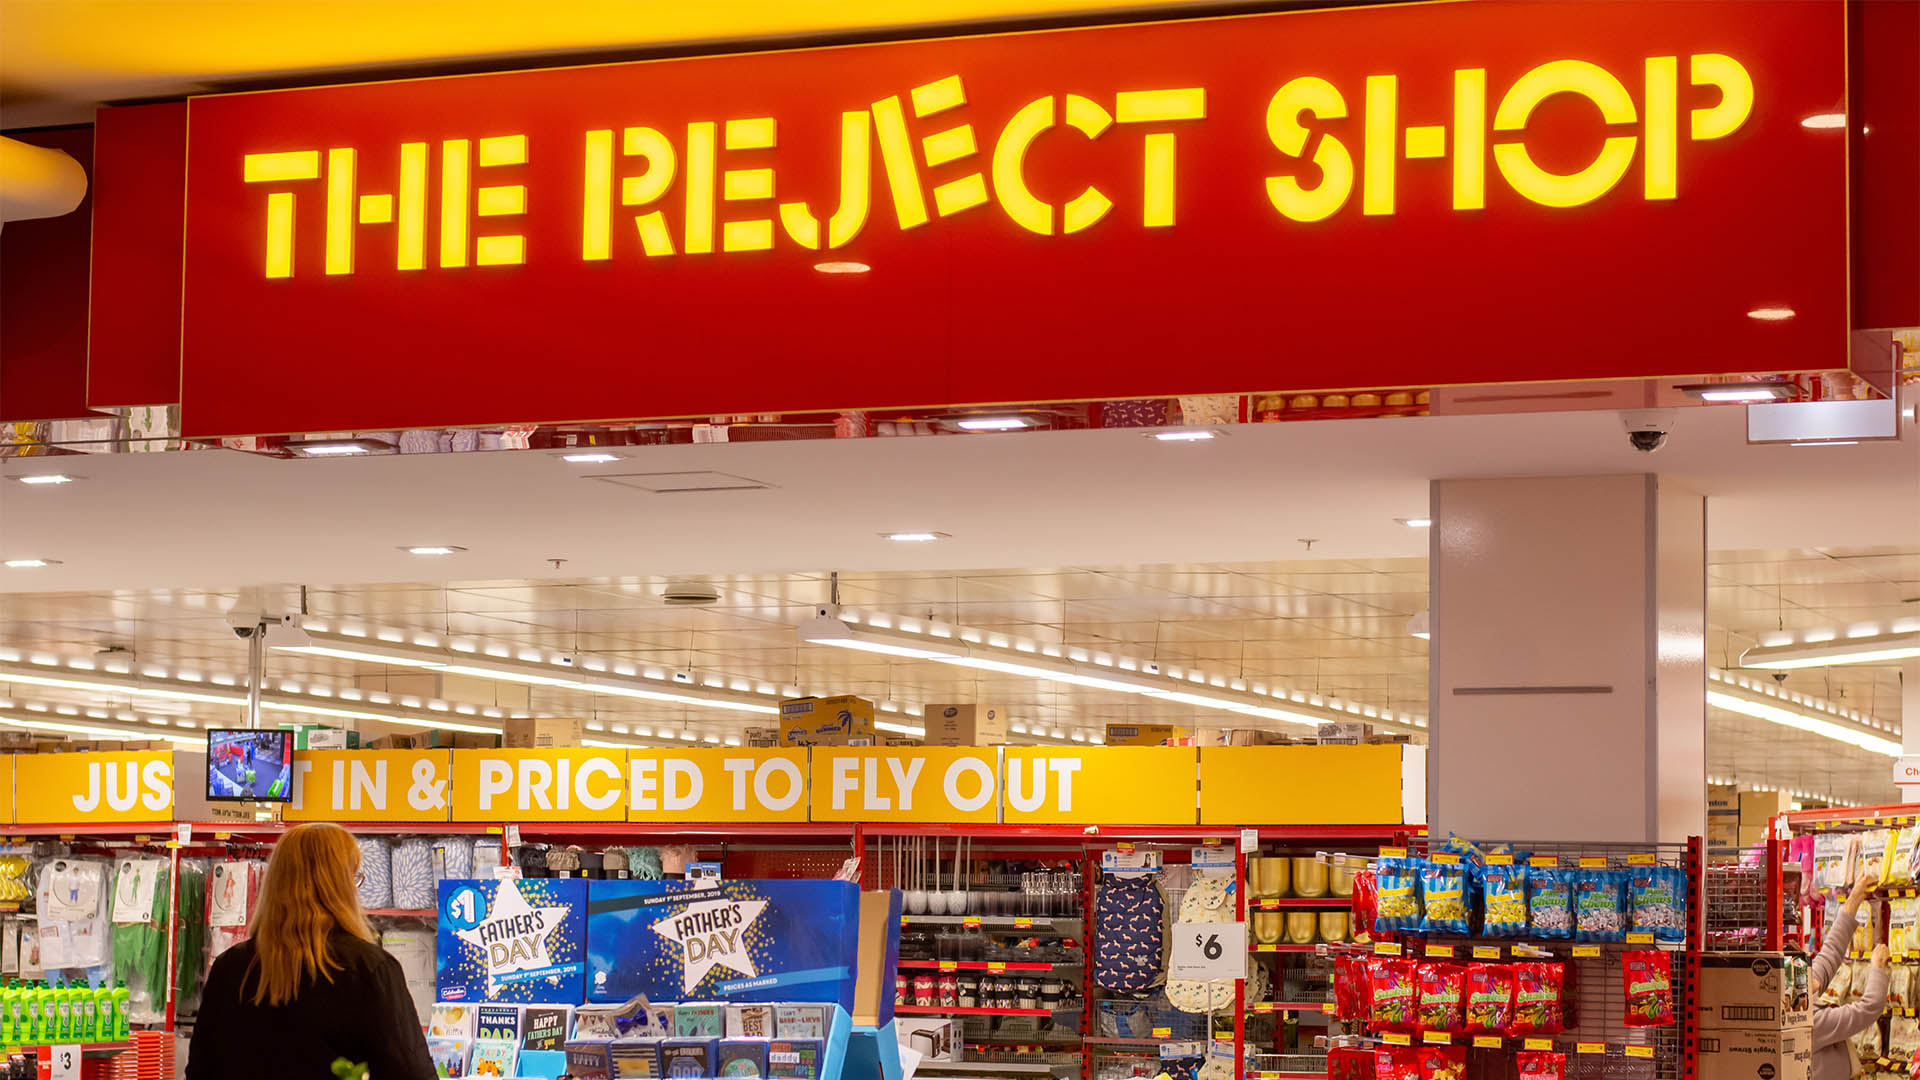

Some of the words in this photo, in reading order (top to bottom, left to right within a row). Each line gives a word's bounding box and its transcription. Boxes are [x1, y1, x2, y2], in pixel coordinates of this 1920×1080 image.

[244, 134, 528, 278] THE
[582, 74, 1206, 261] REJECT
[1265, 53, 1754, 222] SHOP
[331, 759, 387, 810] IN
[407, 758, 447, 811] &
[479, 757, 703, 811] PRICED
[724, 757, 803, 811] TO
[832, 757, 926, 811] FLY
[943, 756, 1082, 812] OUT
[451, 889, 475, 923] $1
[644, 896, 665, 905] SUNDAY
[707, 890, 721, 898] 2019
[479, 910, 545, 946] FATHER'S
[675, 904, 742, 940] FATHER'S
[489, 933, 542, 969] DAY
[686, 928, 740, 965] DAY
[1195, 933, 1223, 960] $6
[480, 1016, 516, 1025] THANKS
[480, 1028, 515, 1040] DAD
[527, 1029, 551, 1041] FATHER'S
[552, 1026, 563, 1037] DAY
[533, 1015, 558, 1030] HAPPY
[743, 1019, 762, 1032] BEST
[60, 1052, 71, 1070] $3
